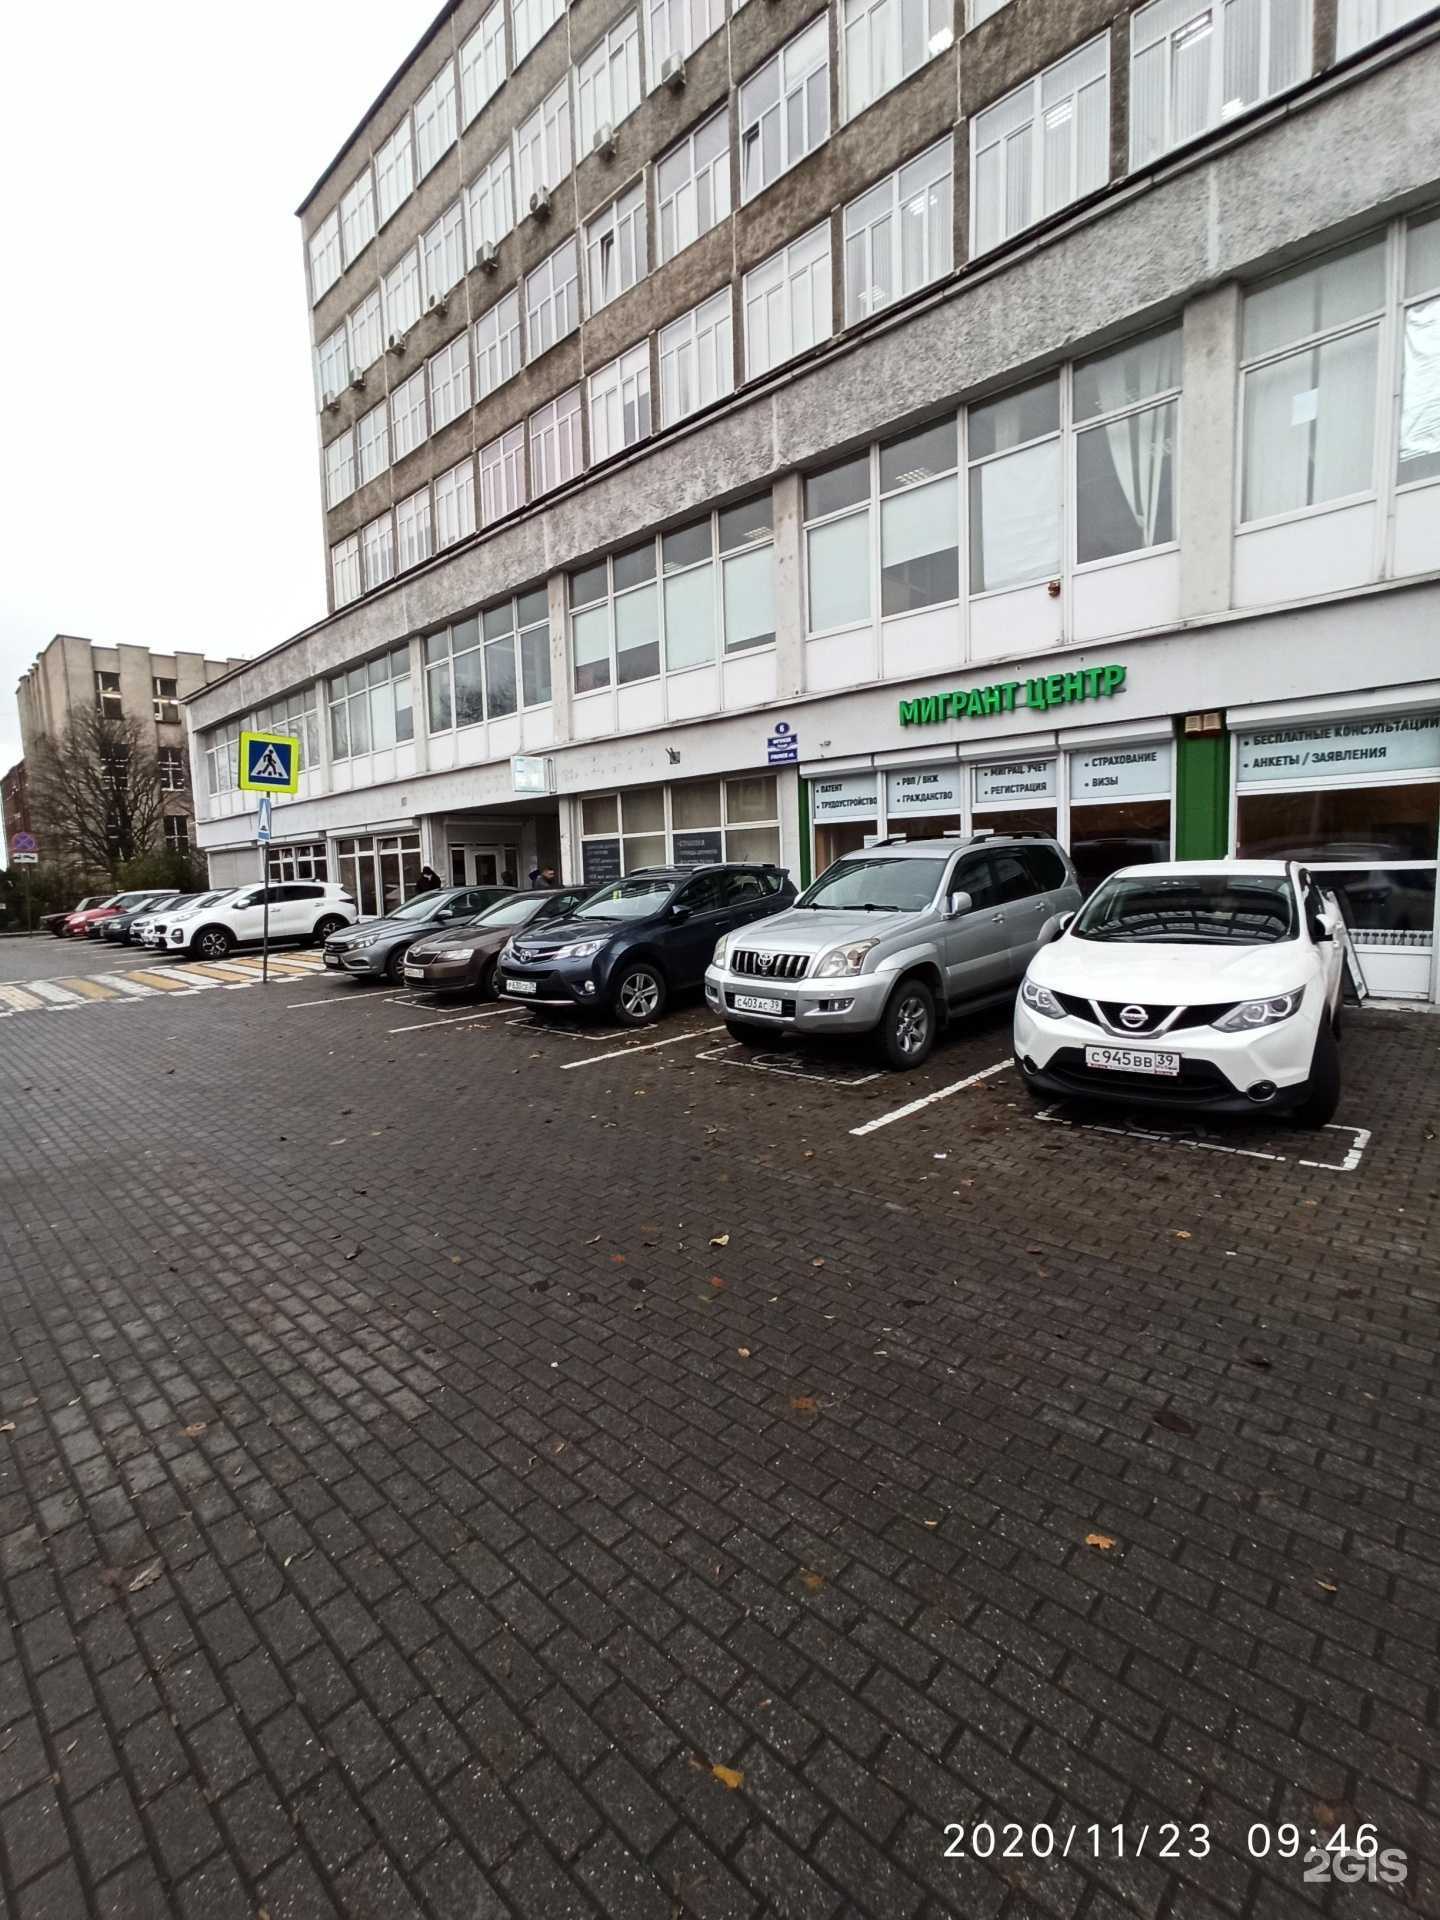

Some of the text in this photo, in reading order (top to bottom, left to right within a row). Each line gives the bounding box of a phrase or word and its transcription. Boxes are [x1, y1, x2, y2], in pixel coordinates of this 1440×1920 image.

[899, 664, 1128, 727] МИГРАНТ ЦЕНТР
[1253, 717, 1440, 746] БЕСПЛАТНЫЕ КОНСУЛЬТАЦИИ
[1091, 751, 1158, 768] СТРАХОВАНИЕ
[1253, 754, 1300, 769] АНКЕТЫ
[1311, 747, 1387, 764] ЗАЯВЛЕНИЯ
[820, 783, 843, 793] ПАТЕНТ
[990, 782, 1047, 795] РЕГИСТРАЦИЯ
[1092, 776, 1119, 788] ВИЗЫ
[821, 796, 878, 810] ТРУДОУСТРОЙСТВО
[902, 791, 953, 803] ГРАЖДАНСТВО
[1091, 1050, 1174, 1068] С945ВВ 39
